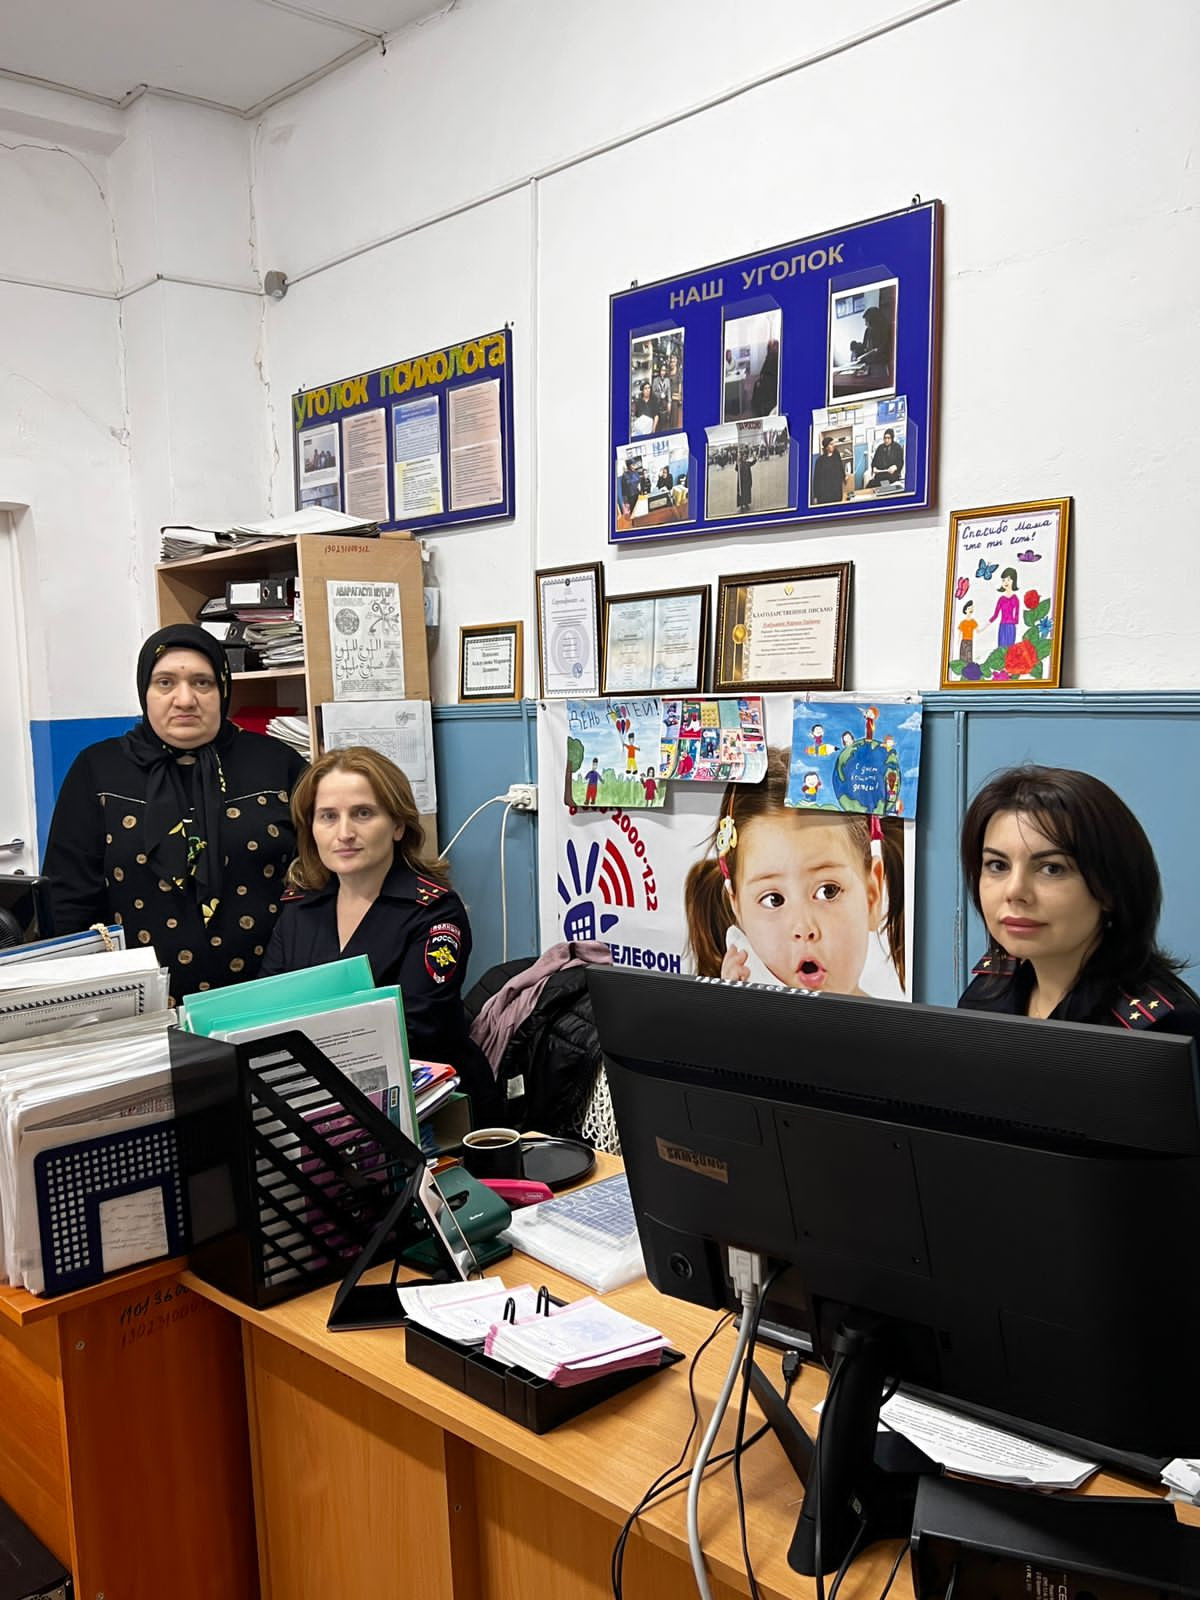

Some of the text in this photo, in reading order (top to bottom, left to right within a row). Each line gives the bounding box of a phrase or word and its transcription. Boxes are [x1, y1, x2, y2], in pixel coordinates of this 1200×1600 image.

[669, 243, 845, 311] НАШ УГОЛОК
[962, 519, 1053, 540] Спасибо Мама
[963, 532, 1036, 551] что ты есть!
[569, 710, 600, 731] ДЕНЬ
[604, 943, 681, 975] ЕЛЕФОН
[665, 1147, 728, 1170] SAMSUNG
